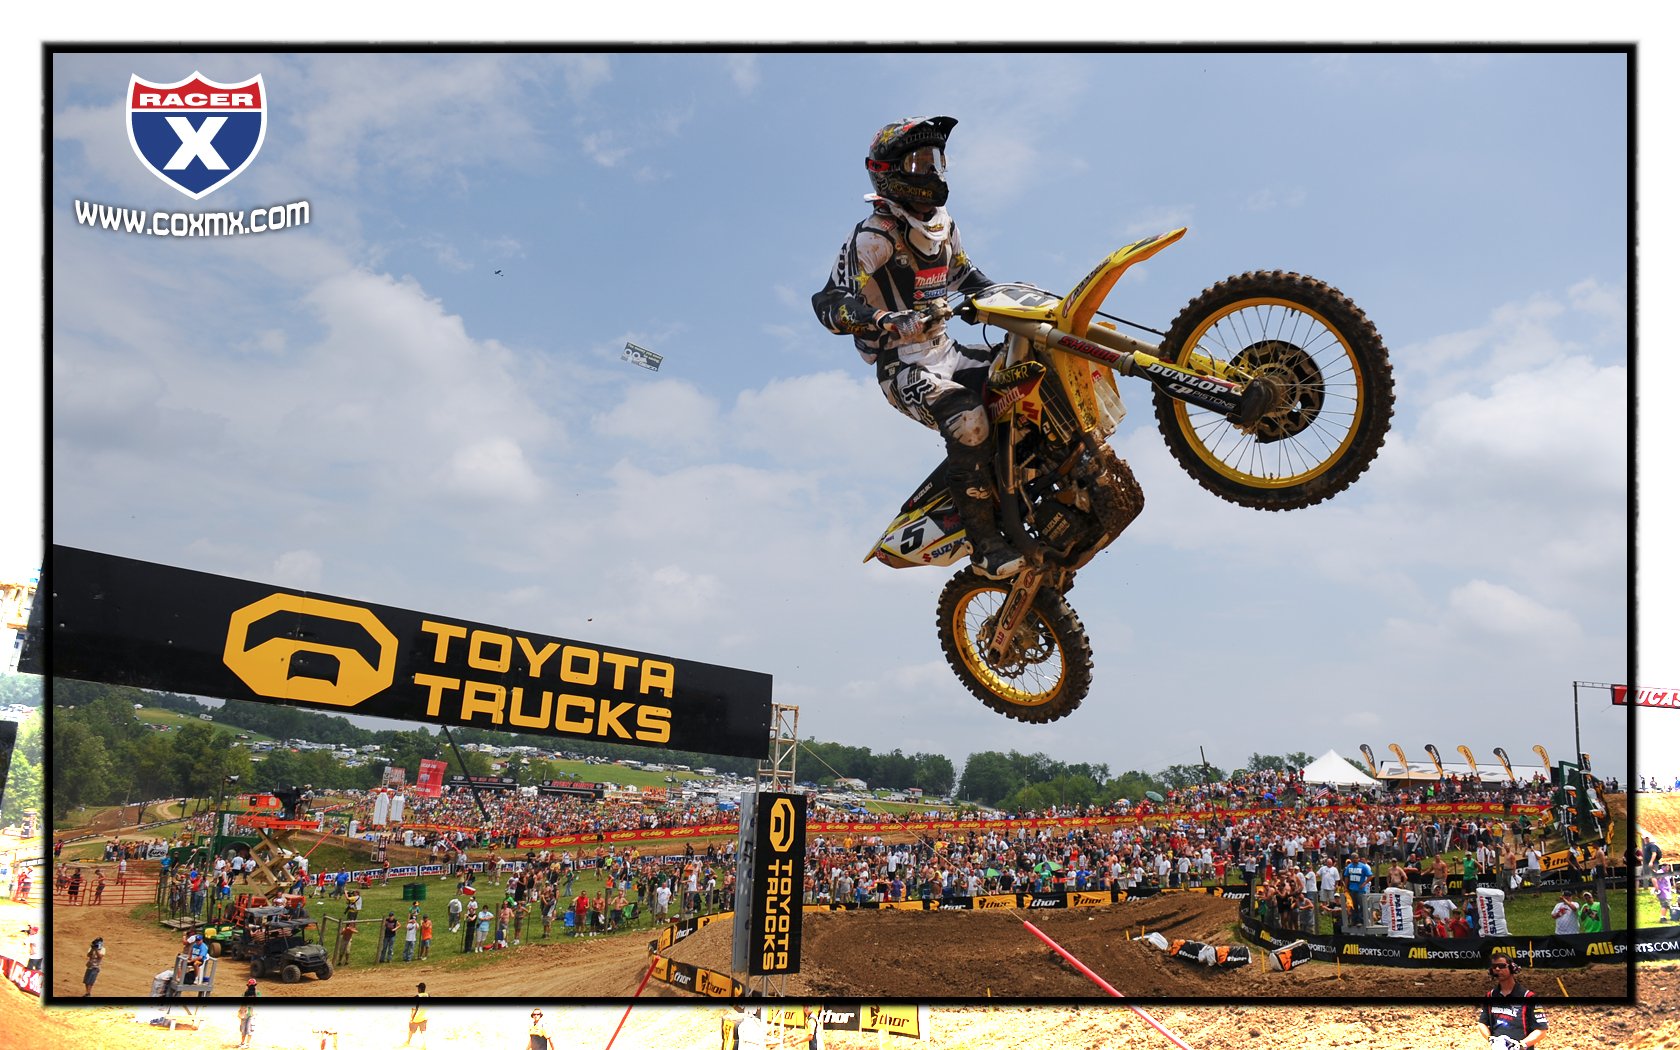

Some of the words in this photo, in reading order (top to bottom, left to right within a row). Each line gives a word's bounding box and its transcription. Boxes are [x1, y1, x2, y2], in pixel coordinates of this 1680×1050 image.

[1058, 335, 1120, 363] SHOWA
[1148, 363, 1229, 396] DUNLOP
[1192, 390, 1236, 410] PISTONS
[900, 518, 928, 555] 5
[420, 620, 675, 698] TOYOTA
[412, 672, 671, 743] TRUCKS
[762, 859, 780, 971] TRUCKS
[776, 859, 793, 970] TOYOTA
[1030, 897, 1060, 907] thor
[1394, 894, 1404, 931] PARTS
[1484, 896, 1497, 934] PARTS
